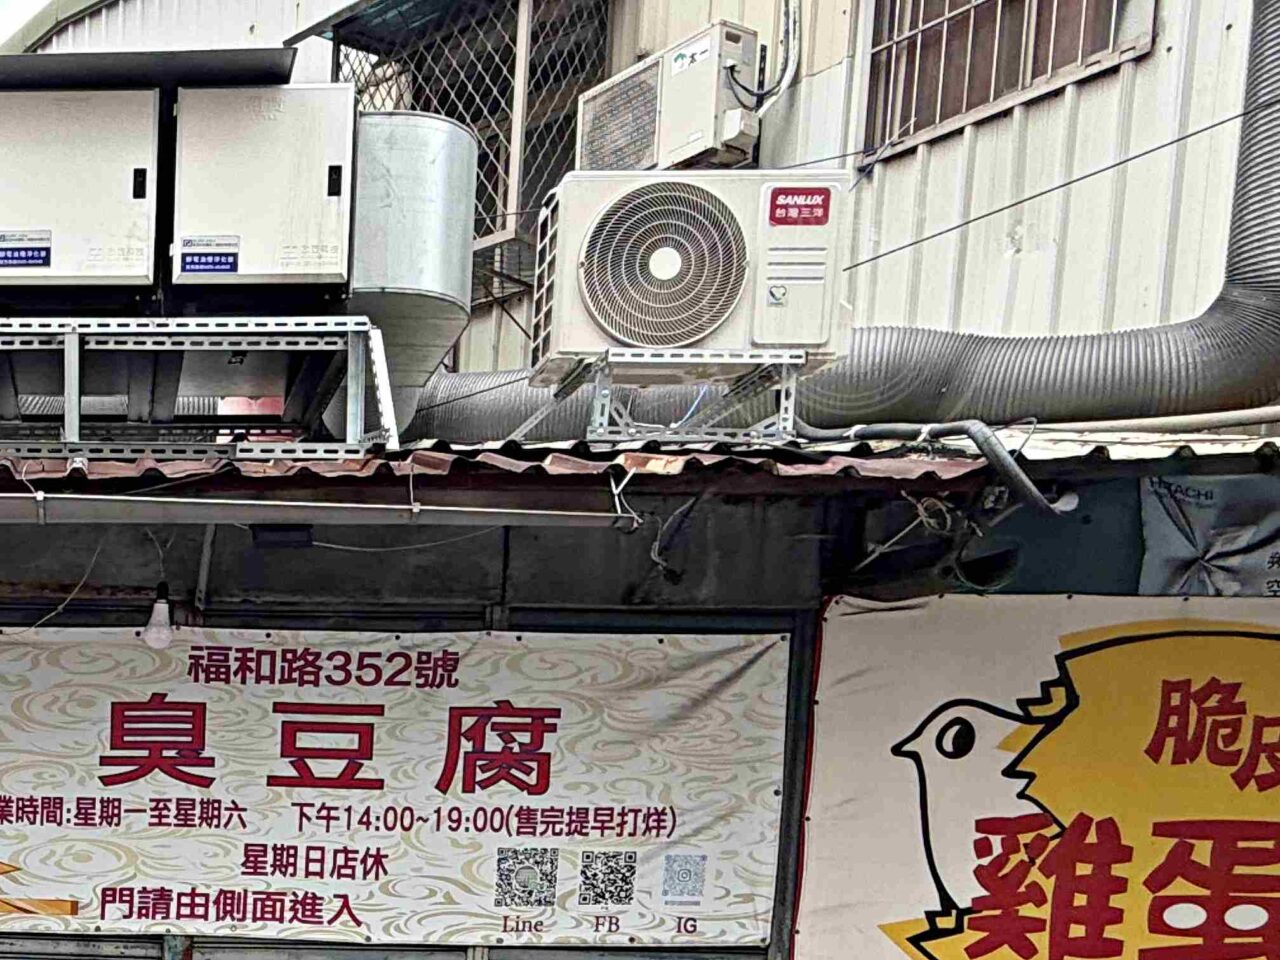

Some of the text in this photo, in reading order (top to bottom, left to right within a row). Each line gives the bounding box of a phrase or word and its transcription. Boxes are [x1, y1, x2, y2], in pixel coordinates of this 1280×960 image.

[776, 195, 824, 205] SANLUX
[775, 207, 824, 218] 台灣三洋
[188, 645, 460, 689] 福和路352號
[98, 692, 562, 796] 臭豆腐
[240, 843, 390, 881] 星期日店休
[99, 887, 363, 928] 門請由側面進入
[502, 915, 544, 933] Line
[594, 916, 621, 933] FB
[676, 917, 698, 933] IG
